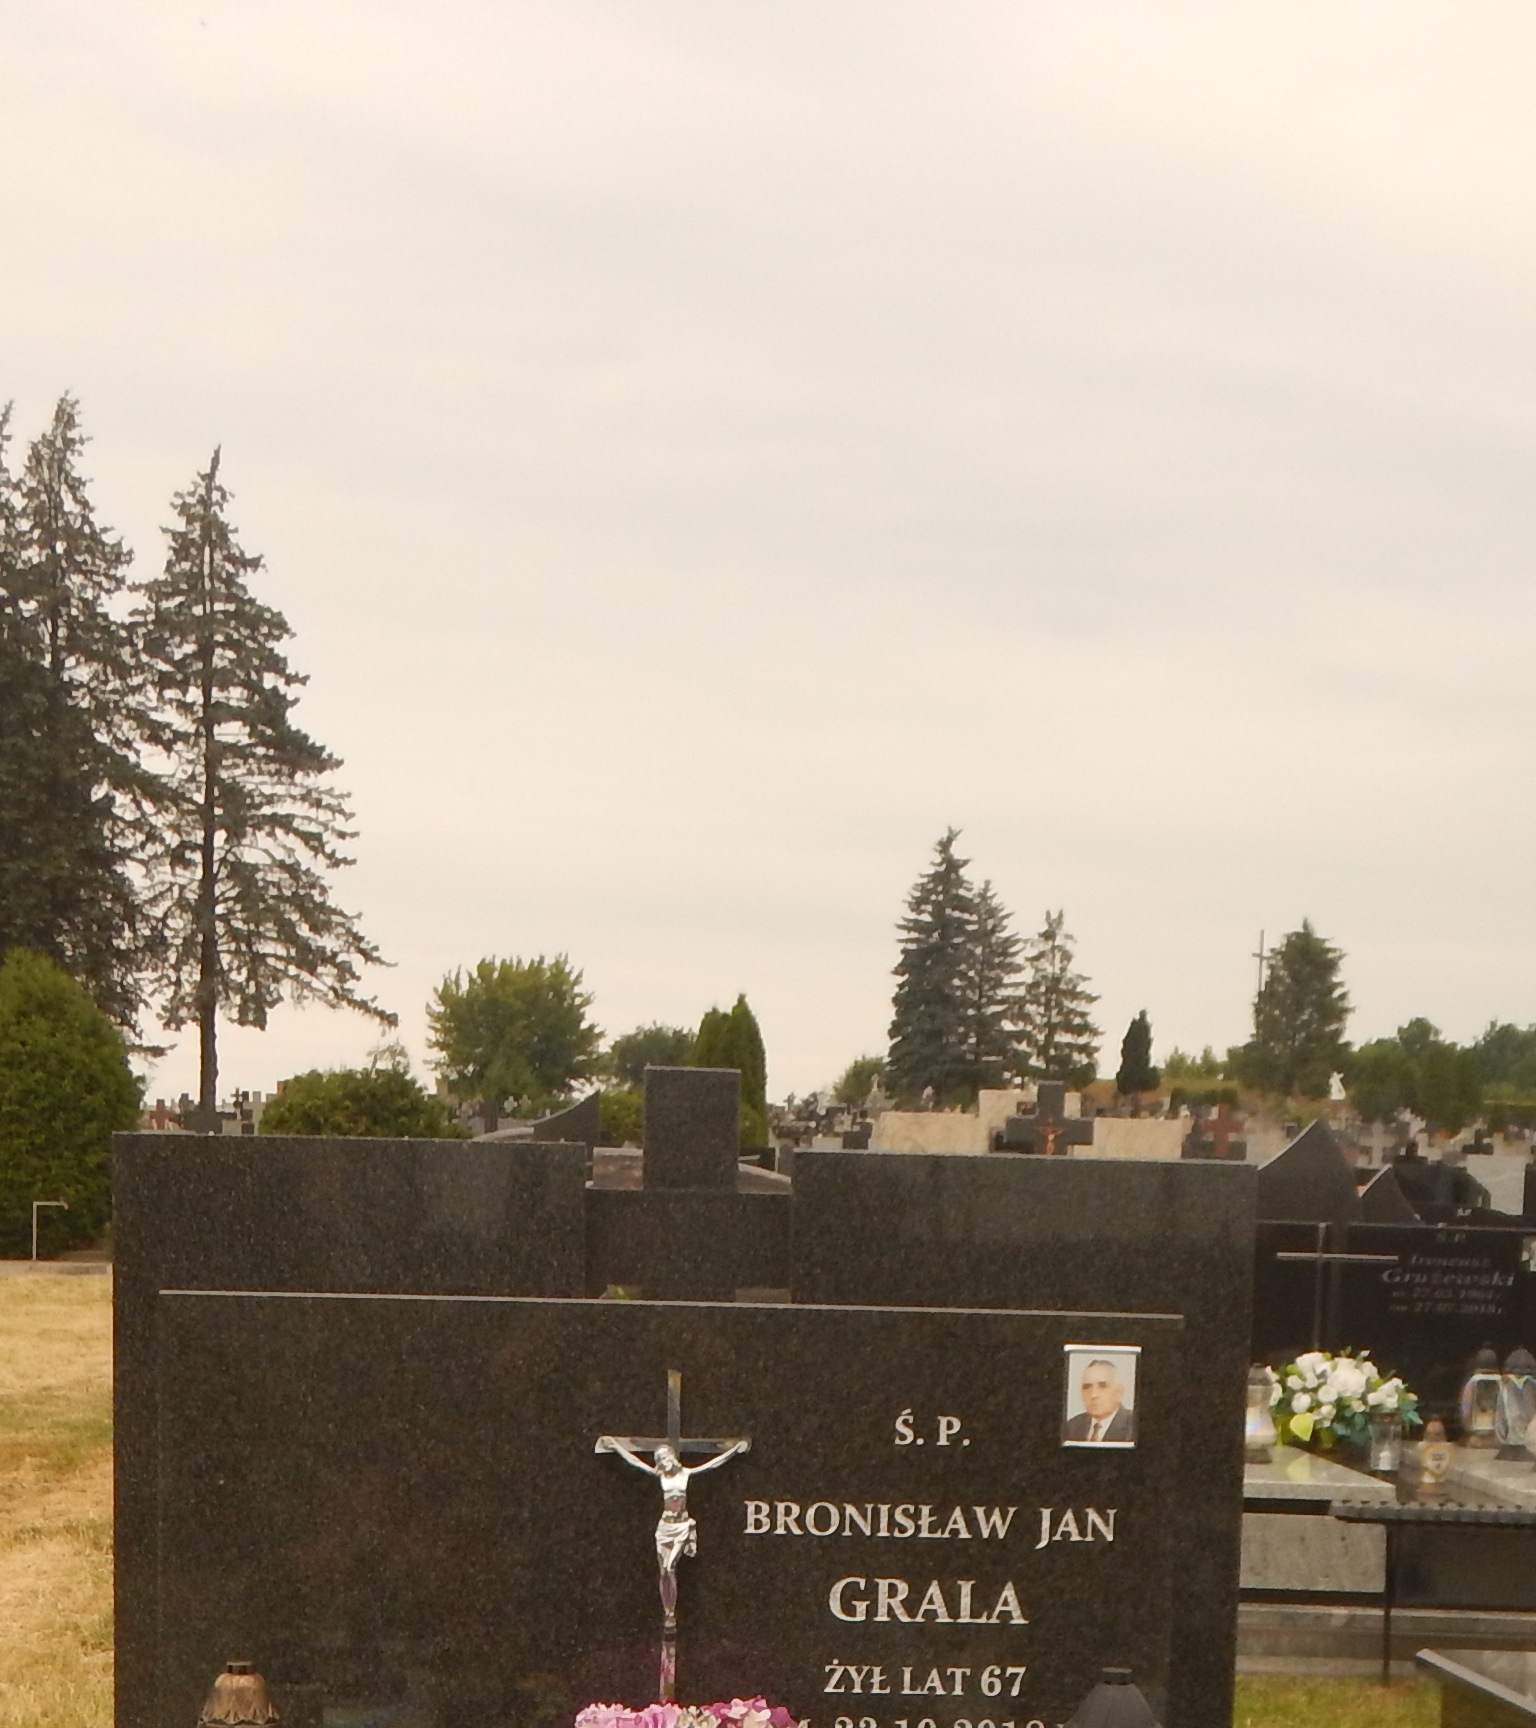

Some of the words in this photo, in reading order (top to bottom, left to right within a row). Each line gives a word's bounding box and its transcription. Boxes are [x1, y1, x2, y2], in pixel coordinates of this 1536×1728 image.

[894, 1408, 925, 1446] Ś.
[935, 1415, 971, 1446] P.
[743, 1499, 1018, 1540] BRONISŁAW
[1034, 1506, 1119, 1550] JAN
[828, 1575, 1030, 1625] GRALA
[823, 1658, 892, 1695] ŻYŁ
[900, 1666, 972, 1697] LAT
[979, 1664, 1028, 1698] 67
